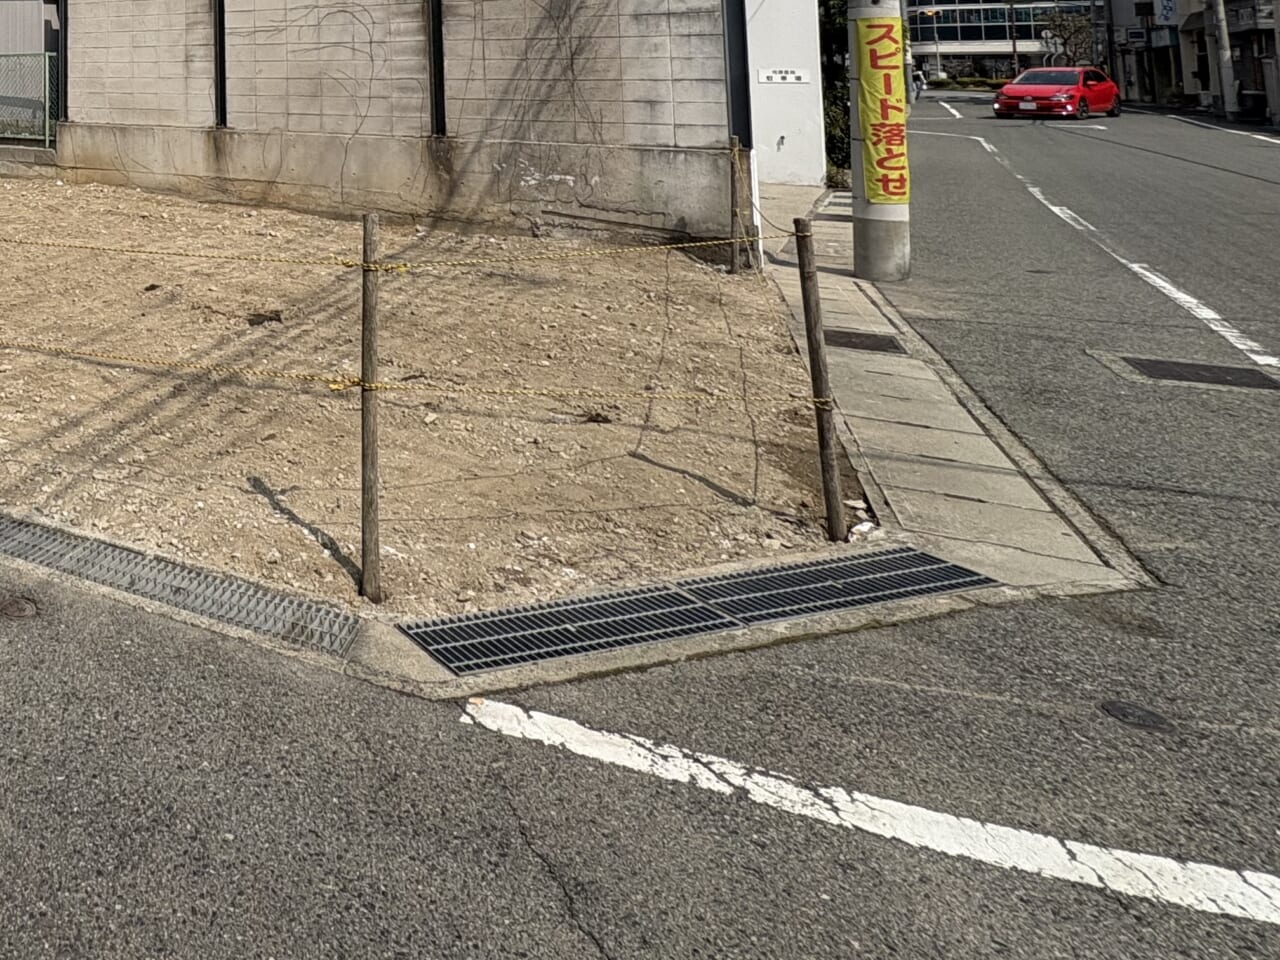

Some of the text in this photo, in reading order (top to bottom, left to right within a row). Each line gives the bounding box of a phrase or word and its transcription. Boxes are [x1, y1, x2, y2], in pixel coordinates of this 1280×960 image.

[865, 22, 909, 198] スピード落とせ
